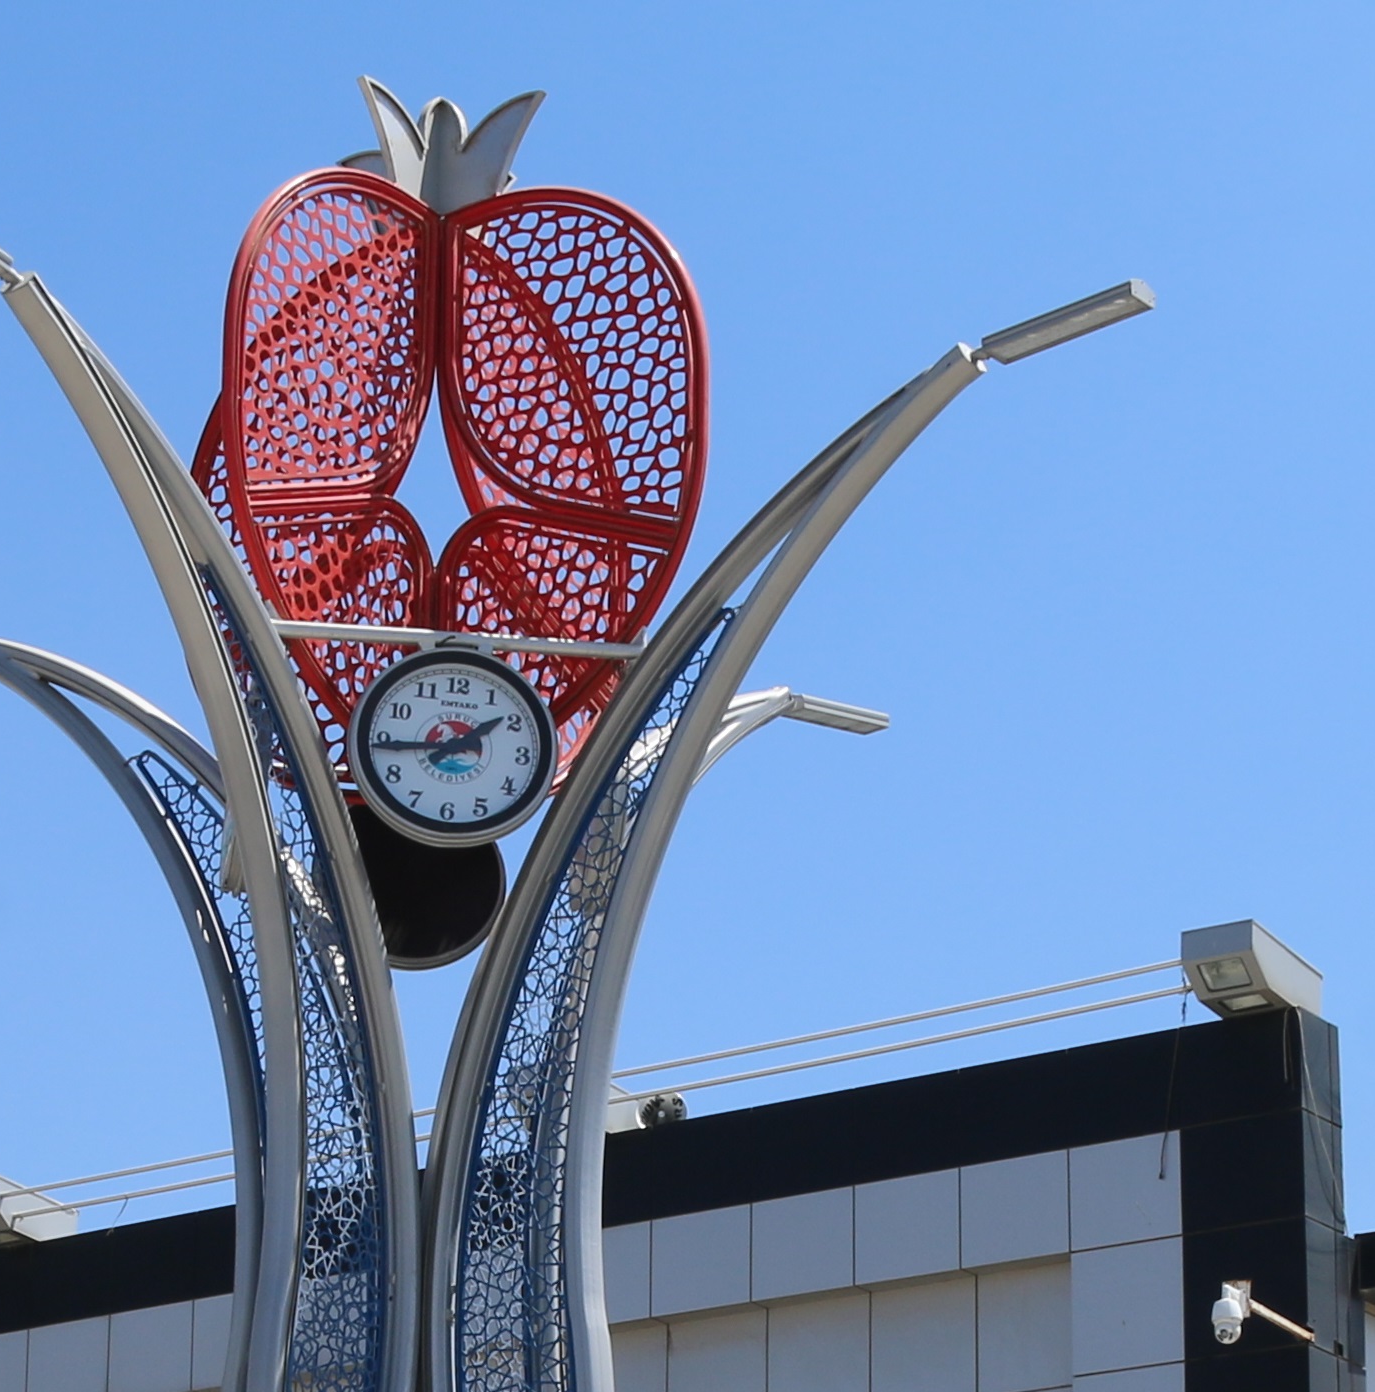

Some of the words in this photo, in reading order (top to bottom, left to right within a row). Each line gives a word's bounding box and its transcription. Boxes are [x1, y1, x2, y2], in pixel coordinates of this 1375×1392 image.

[414, 681, 438, 700] 11
[445, 677, 470, 696] 12
[485, 688, 498, 706] 1
[389, 702, 412, 720] 10
[506, 714, 523, 733] 2
[515, 746, 531, 766] 3
[385, 764, 402, 784] 8
[500, 775, 517, 797] 4
[408, 790, 423, 808] 7
[472, 797, 489, 818] 5
[438, 802, 455, 820] 6
